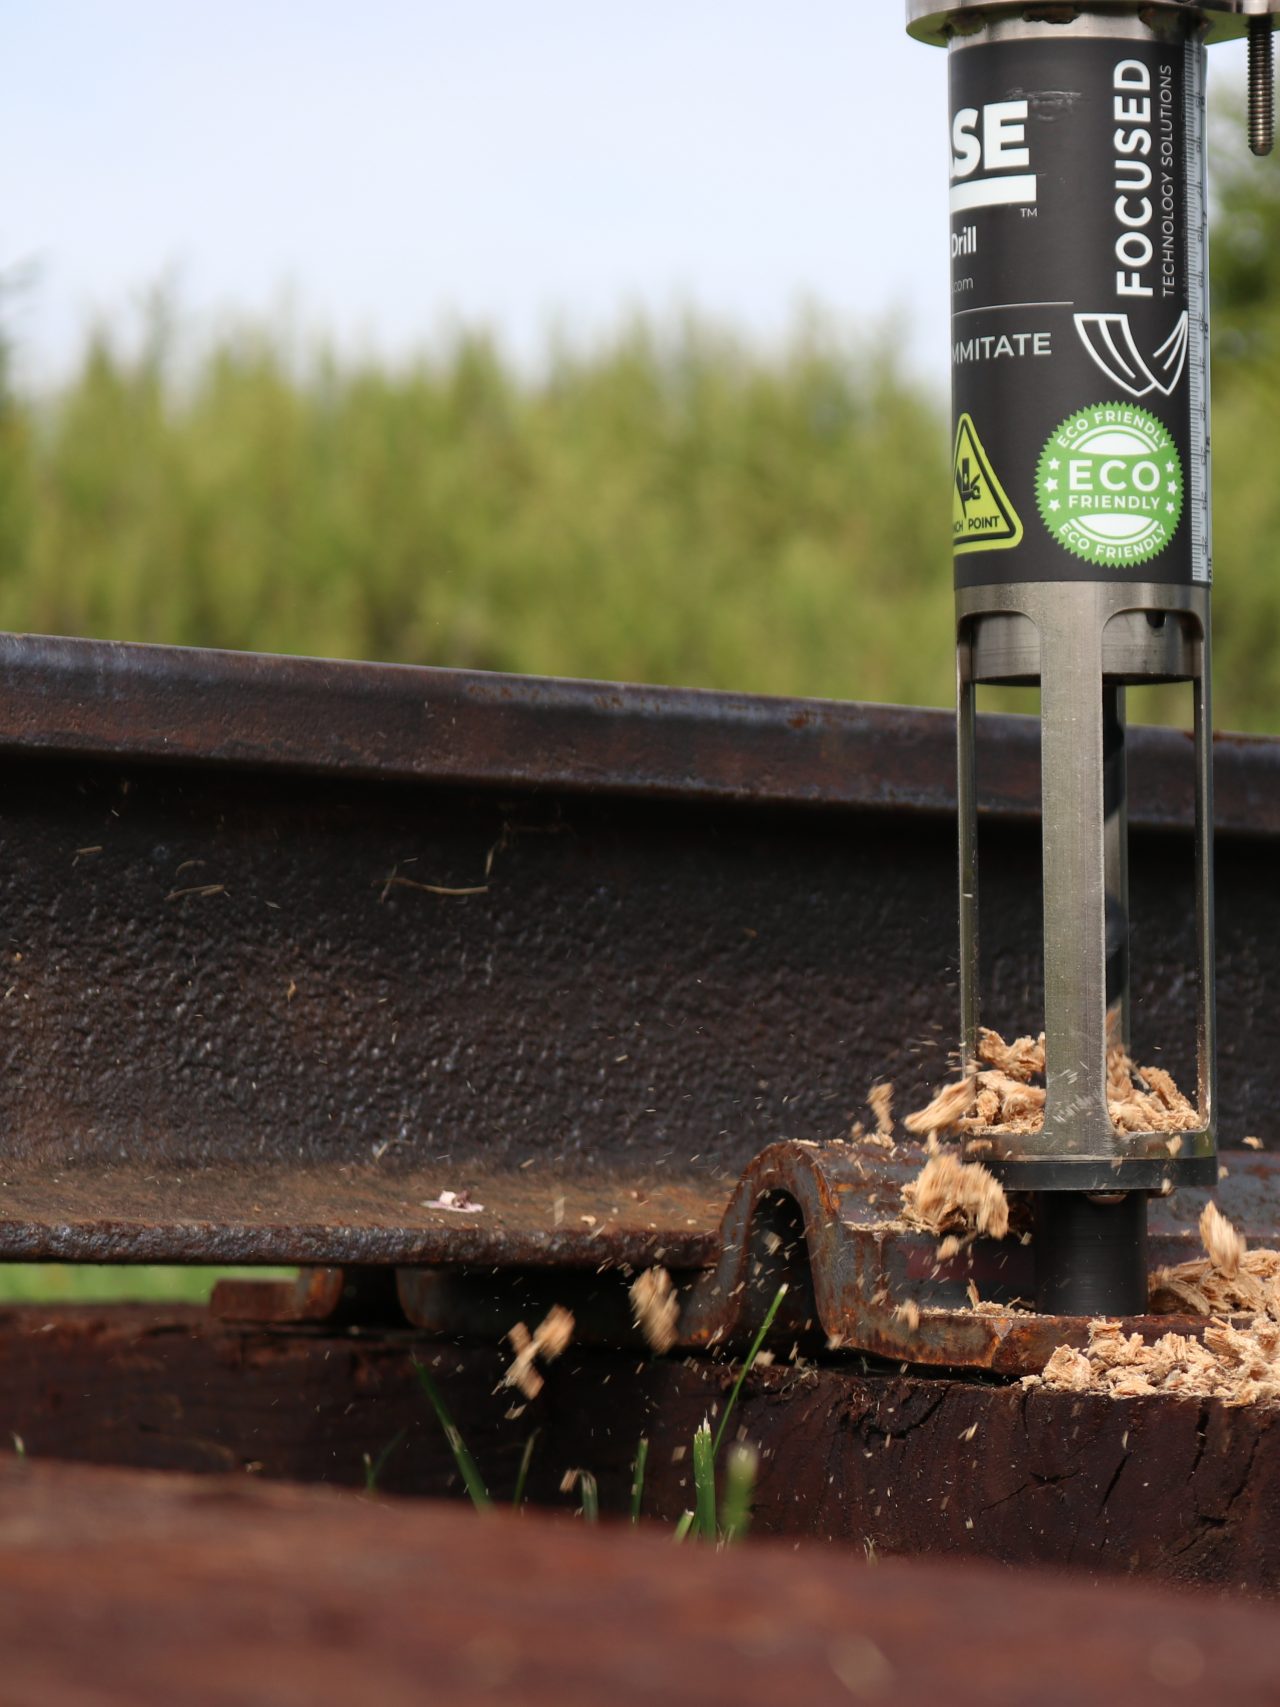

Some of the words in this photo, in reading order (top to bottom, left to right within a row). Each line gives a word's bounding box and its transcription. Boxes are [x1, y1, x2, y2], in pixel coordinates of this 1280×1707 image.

[1159, 63, 1173, 167] SOLUTIONS
[1113, 59, 1154, 297] FOCUSED
[1020, 207, 1038, 218] TM
[951, 225, 977, 259] Drill
[1161, 172, 1176, 298] TECHNOLOGY
[1056, 418, 1089, 449] ECO
[1093, 409, 1169, 450] FRIENDLY
[1068, 459, 1161, 492] ECO
[1068, 494, 1161, 510] FRIENDLY
[968, 515, 1000, 530] POINT
[1058, 522, 1091, 551] ECO
[1094, 523, 1167, 559] FRIENDLY
